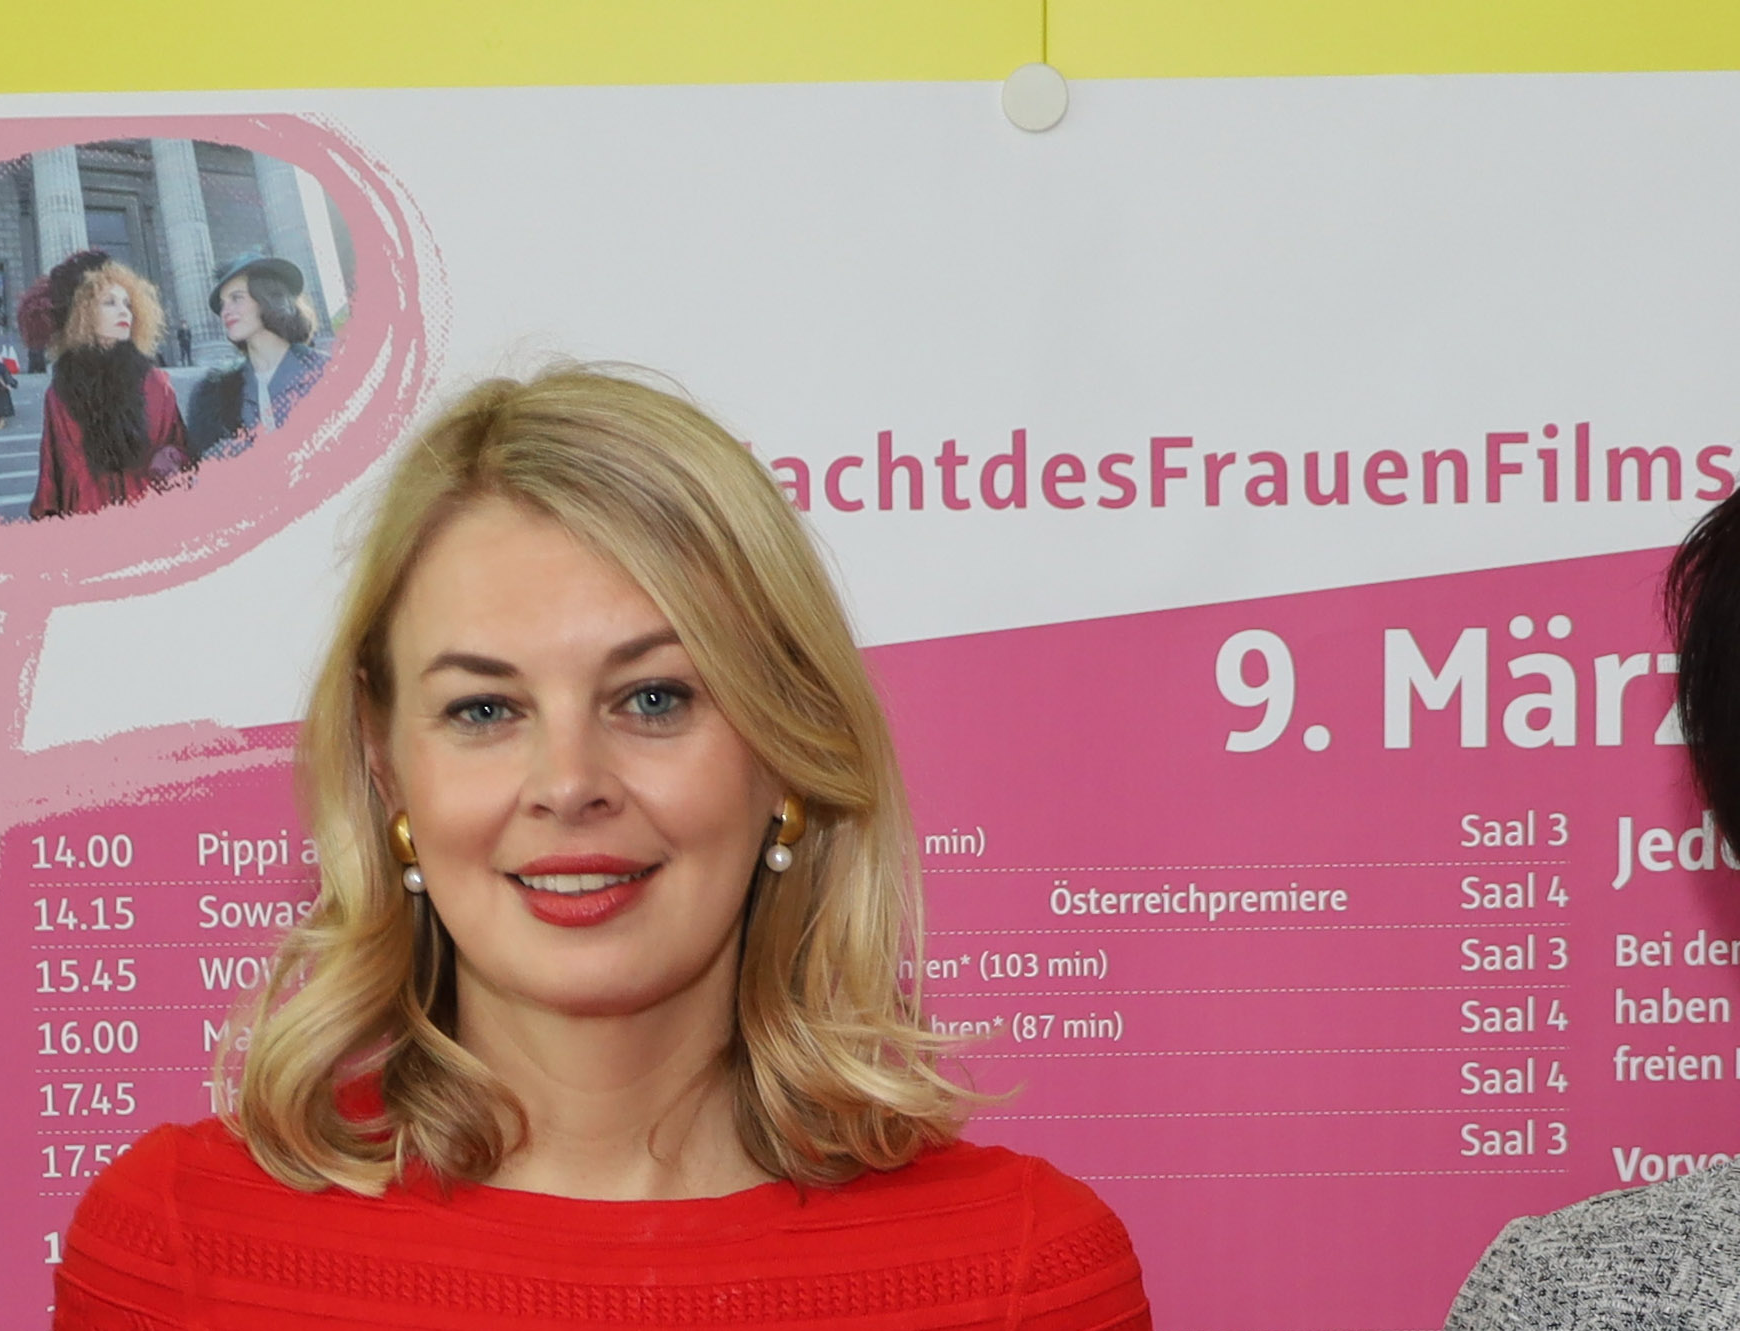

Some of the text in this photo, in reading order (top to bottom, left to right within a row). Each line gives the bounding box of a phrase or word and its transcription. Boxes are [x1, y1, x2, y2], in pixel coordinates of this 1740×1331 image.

[742, 421, 1735, 513] achtdesFrauenFilms
[1213, 627, 1330, 752] 9.
[925, 826, 987, 857] min)
[1460, 809, 1569, 849] Saal 3
[31, 834, 134, 870] 14.00
[197, 830, 289, 876] Pippi
[1050, 880, 1348, 922] Österreichpremiere
[1460, 872, 1570, 910] Saal 4
[33, 896, 136, 931] 14.15
[980, 951, 1039, 981] (103
[1047, 949, 1108, 979] min)
[1460, 934, 1569, 972] Saal 3
[1614, 931, 1672, 968] Bei
[35, 959, 137, 993] 15.45
[1460, 996, 1570, 1034] Saal 4
[1614, 987, 1730, 1024] haben
[37, 1020, 139, 1055] 16.00
[1012, 1012, 1055, 1042] (87
[1063, 1011, 1124, 1041] min)
[1460, 1058, 1570, 1096] Saal 4
[1613, 1045, 1721, 1082] freien
[39, 1082, 136, 1117] 17.45
[1460, 1120, 1569, 1158] Saal 3
